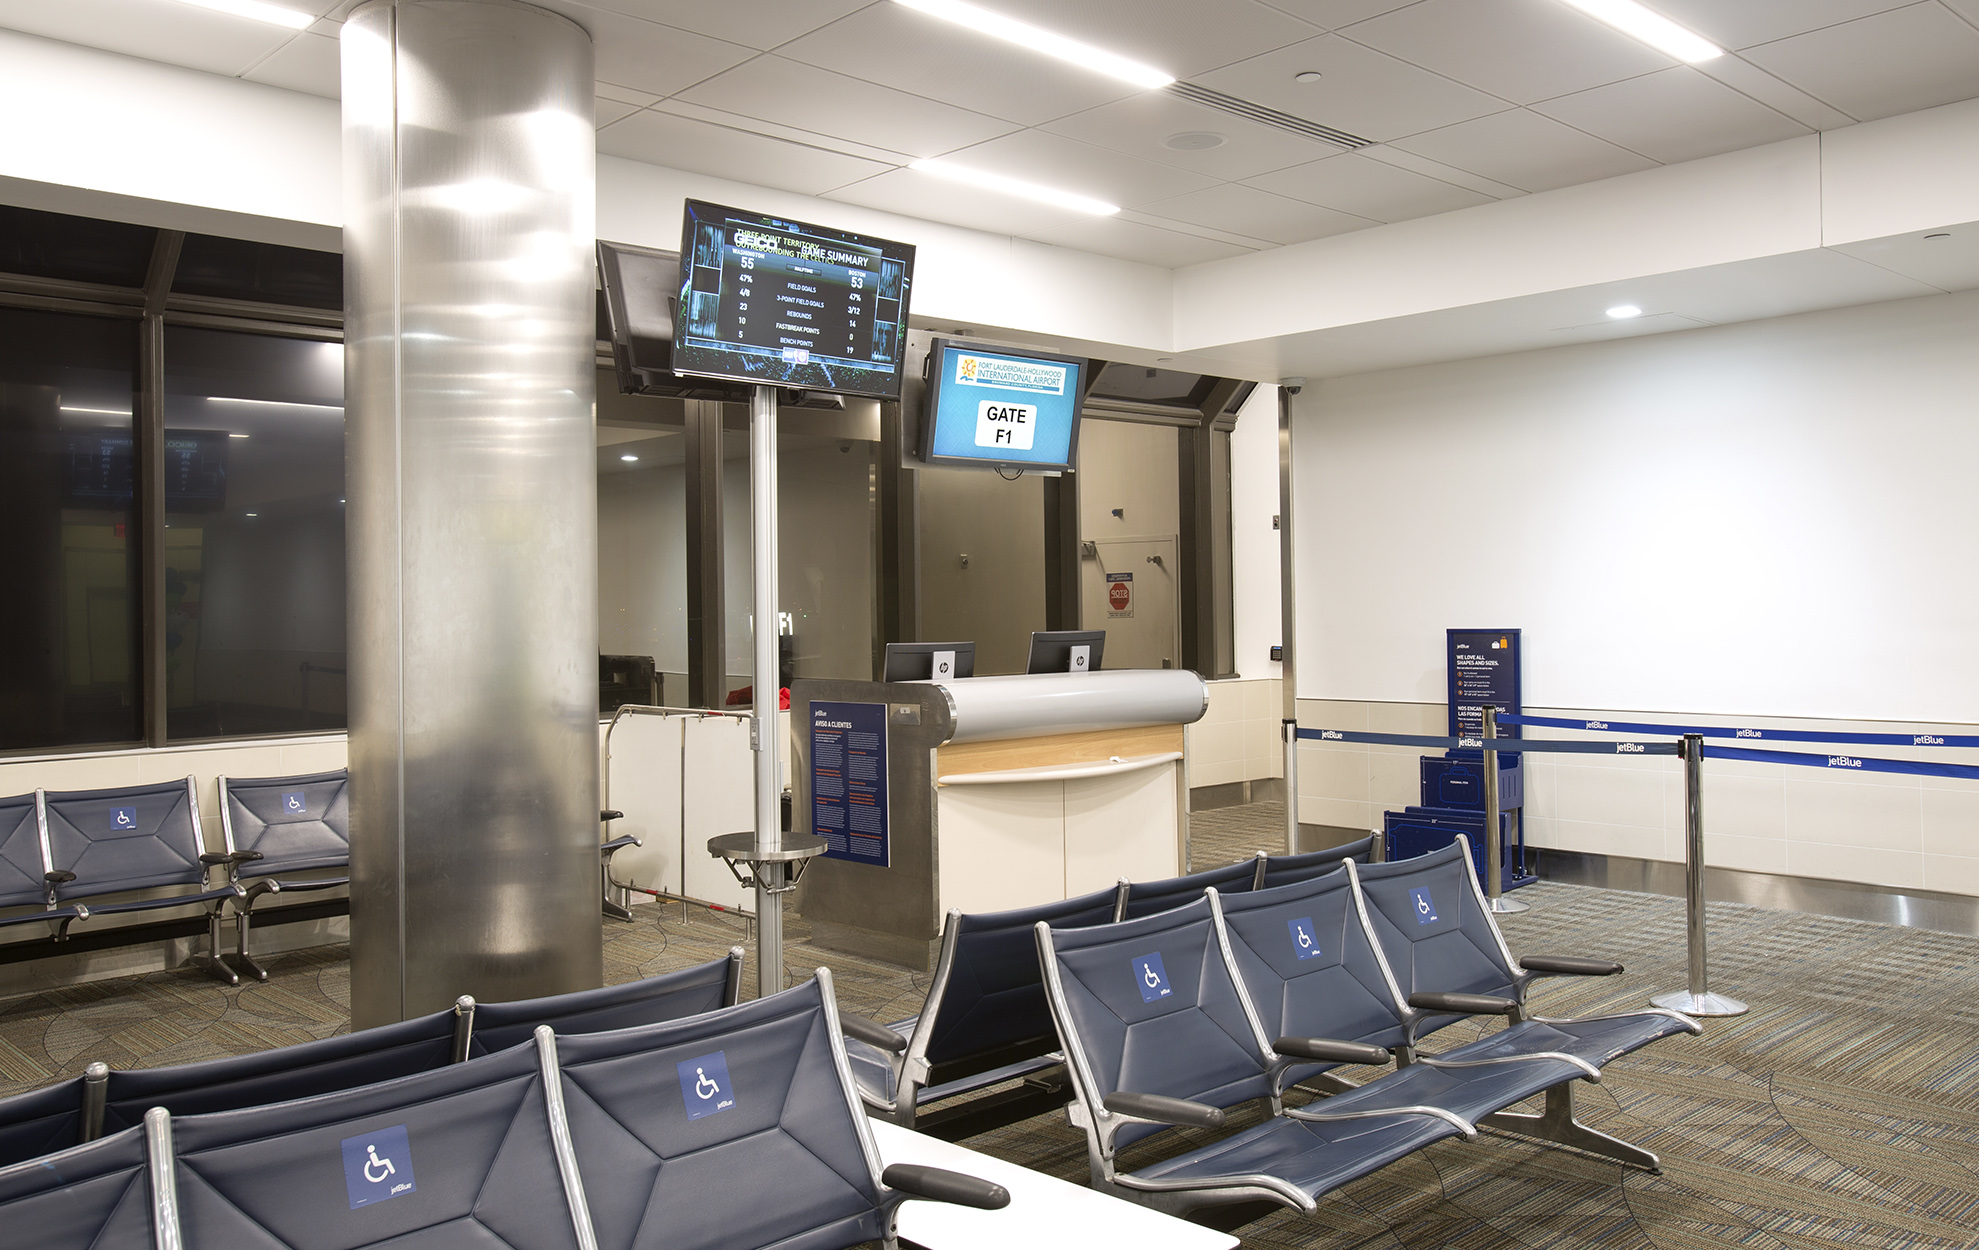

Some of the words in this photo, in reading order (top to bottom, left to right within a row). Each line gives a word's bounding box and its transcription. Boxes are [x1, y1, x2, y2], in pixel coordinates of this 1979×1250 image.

[734, 232, 777, 250] GEICO
[783, 237, 820, 249] TERRITORY
[732, 248, 765, 259] WASHINGTON
[802, 246, 826, 258] GAME
[827, 250, 868, 267] SUMMARY
[741, 256, 754, 270] 55
[739, 274, 753, 283] 47%
[851, 277, 863, 289] 53
[740, 288, 750, 297] 4/8
[787, 283, 800, 291] FIELD
[801, 285, 816, 293] GOALS
[776, 295, 795, 304] 3-POINT
[796, 298, 809, 306] FIELD
[810, 300, 824, 308] GOALS
[849, 293, 861, 302] 47%
[786, 310, 812, 320] REBOUNDS
[848, 306, 860, 315] 3/12
[776, 323, 803, 333] FASTBREAK
[804, 325, 820, 335] POINTS
[850, 320, 856, 328] 14
[780, 337, 796, 345] BENCH
[797, 339, 814, 347] POINTS
[846, 346, 854, 354] 19
[994, 364, 1062, 378] LAUDERDALE-HOLLYWOOD
[978, 370, 1032, 383] INTERNATIONAL
[1033, 377, 1060, 386] AIRPORT
[987, 406, 1026, 423] GATE
[996, 429, 1012, 444] F1
[779, 612, 793, 636] F1
[832, 721, 852, 729] CLIENTES
[1586, 721, 1608, 730] jetBlue
[1322, 730, 1343, 740] jetBlue
[1736, 729, 1762, 738] jetBlue
[1458, 738, 1483, 748] jetBlue
[1913, 735, 1944, 745] jetBlue
[1616, 742, 1645, 754] jetBlue
[1828, 756, 1862, 767] jetBlue
[390, 1182, 412, 1195] jetBlue
